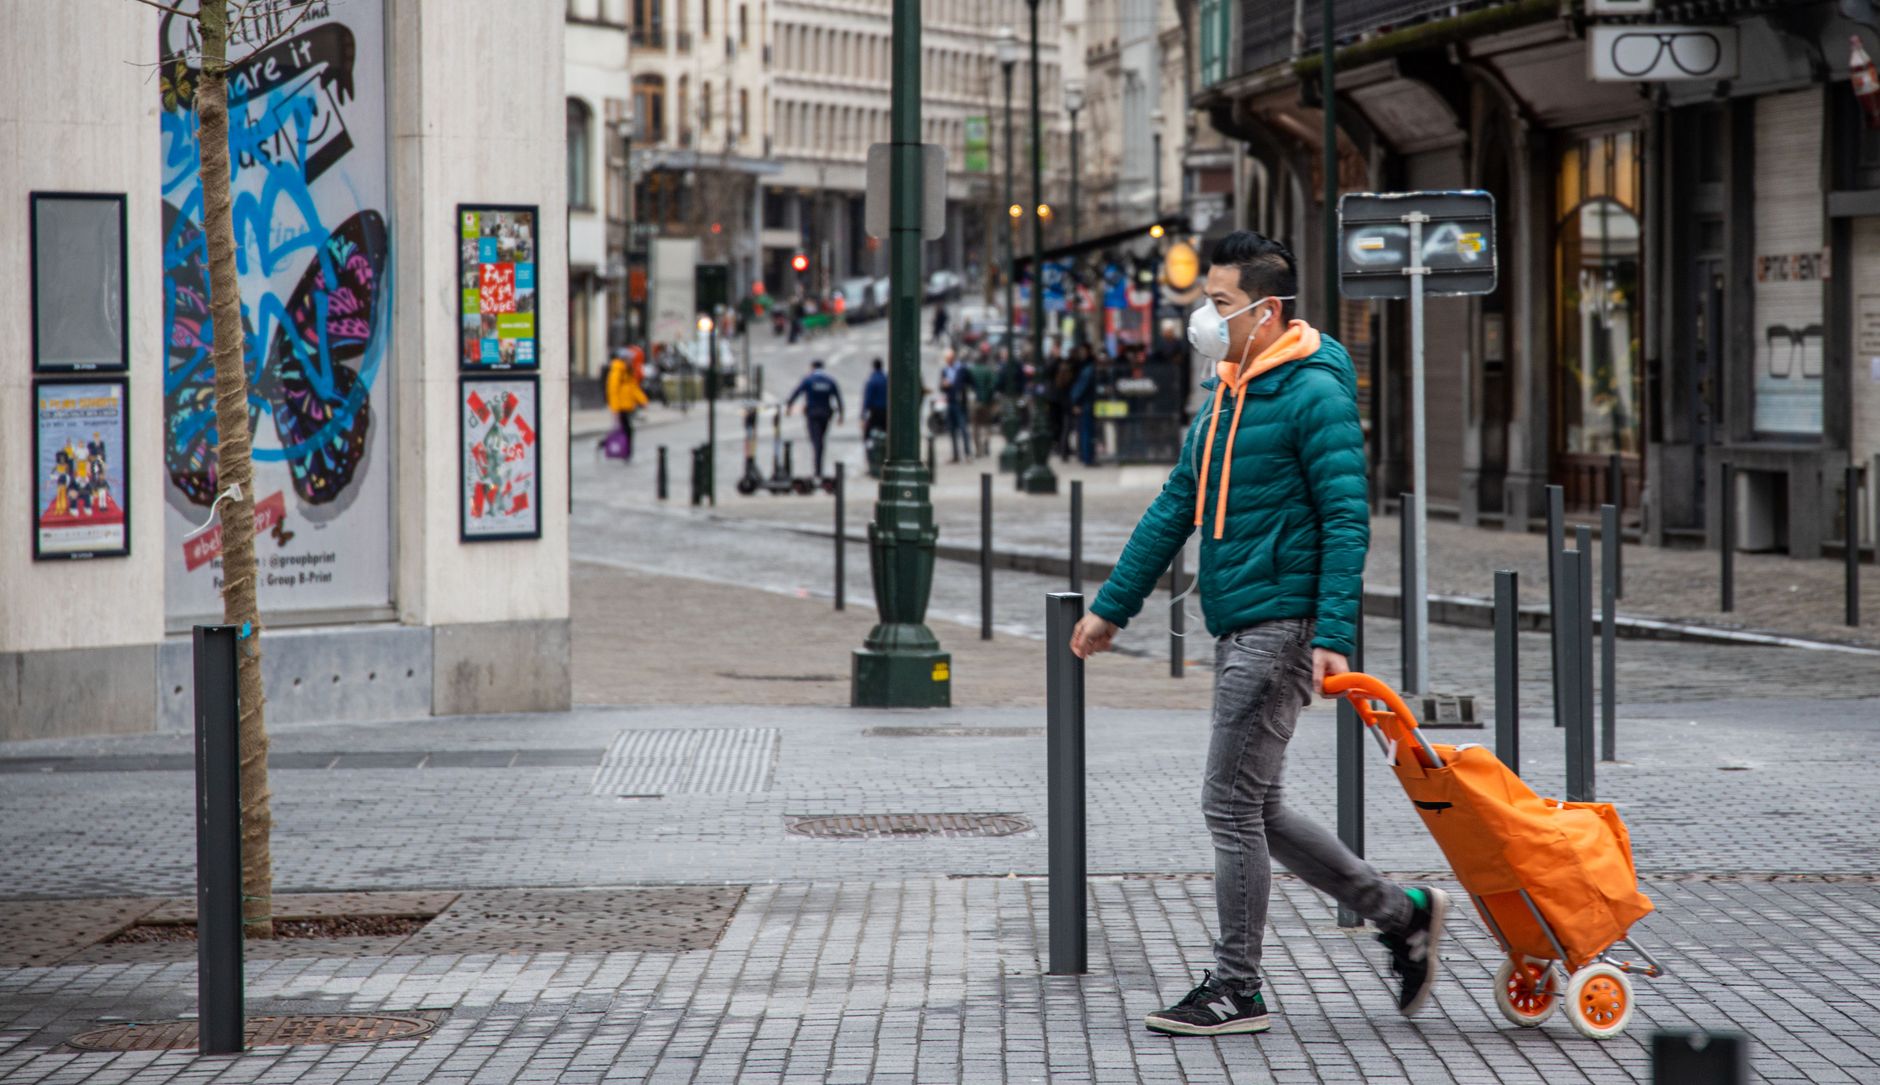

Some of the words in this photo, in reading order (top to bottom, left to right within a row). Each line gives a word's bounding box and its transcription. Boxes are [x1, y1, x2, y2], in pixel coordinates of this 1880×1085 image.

[302, 4, 329, 22] and
[289, 40, 311, 68] it
[267, 573, 296, 587] Group
[299, 571, 332, 585] B-Print
[1207, 995, 1240, 1021] N
